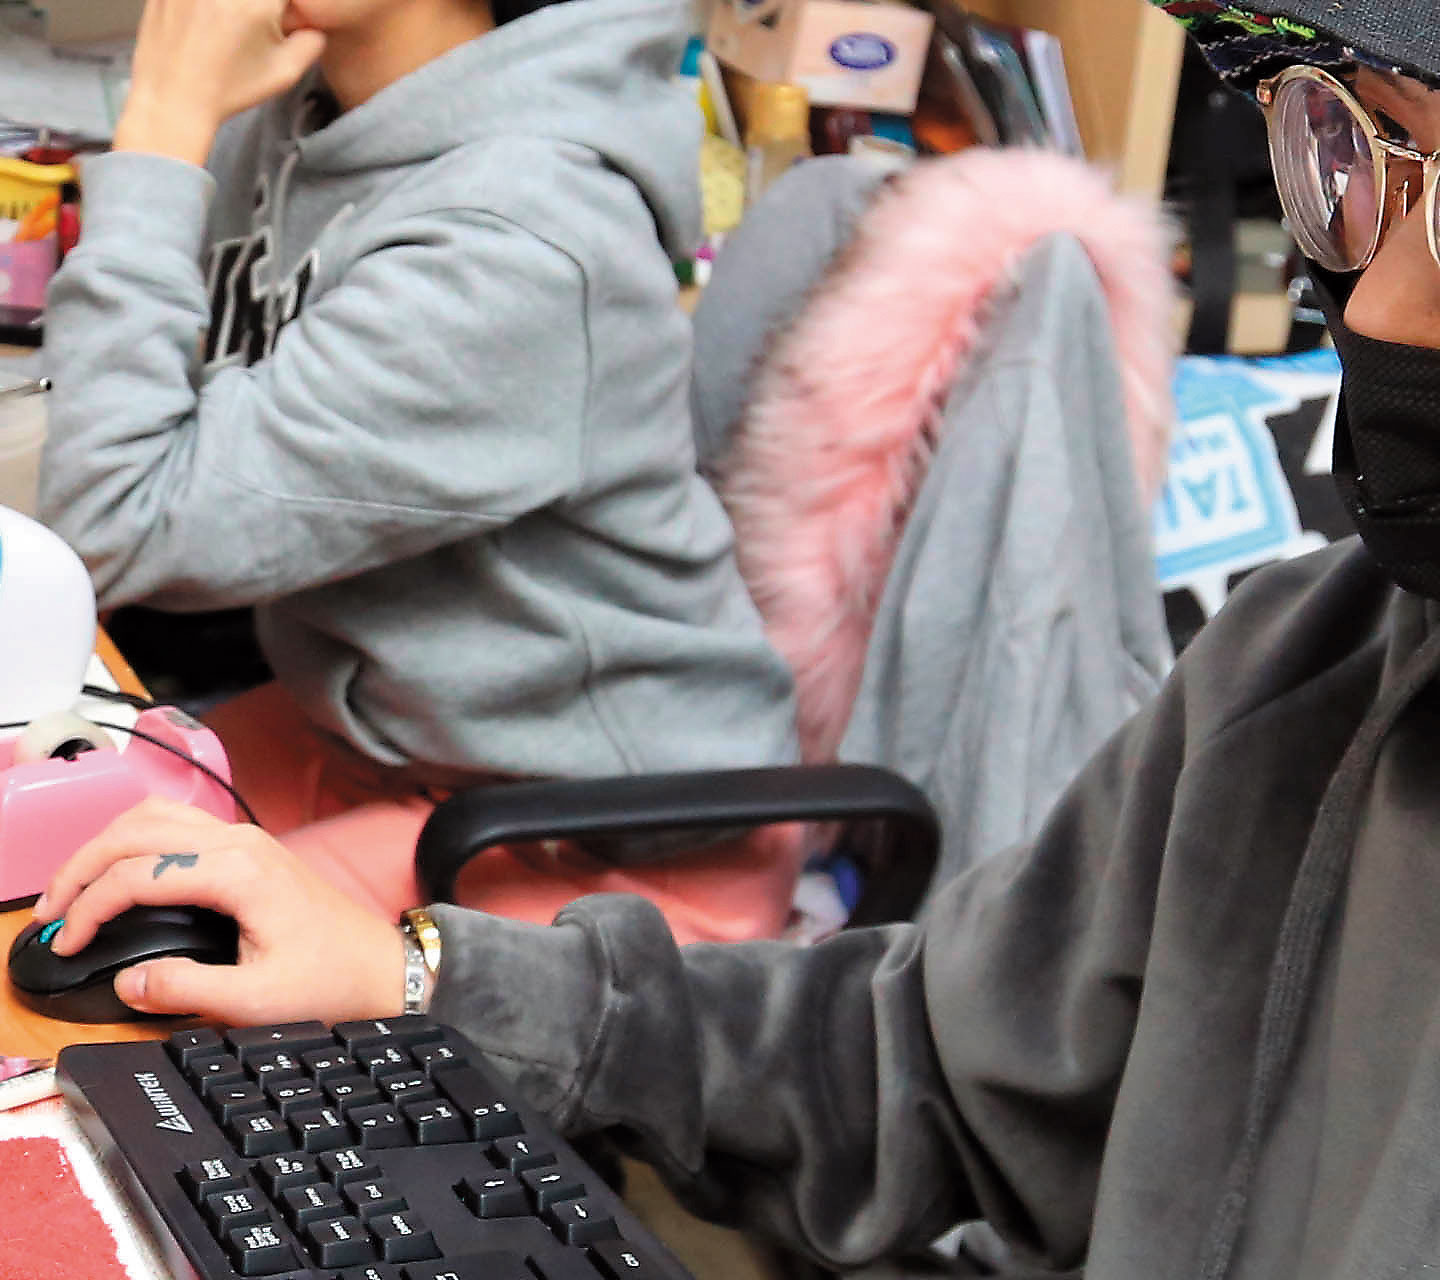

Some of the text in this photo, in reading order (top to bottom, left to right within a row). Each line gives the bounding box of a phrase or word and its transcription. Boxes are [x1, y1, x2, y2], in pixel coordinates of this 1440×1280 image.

[315, 1060, 331, 1068] 6
[335, 1086, 352, 1094] 5
[390, 1082, 406, 1090] 2
[279, 1089, 295, 1097] 8
[473, 1108, 489, 1116] 0
